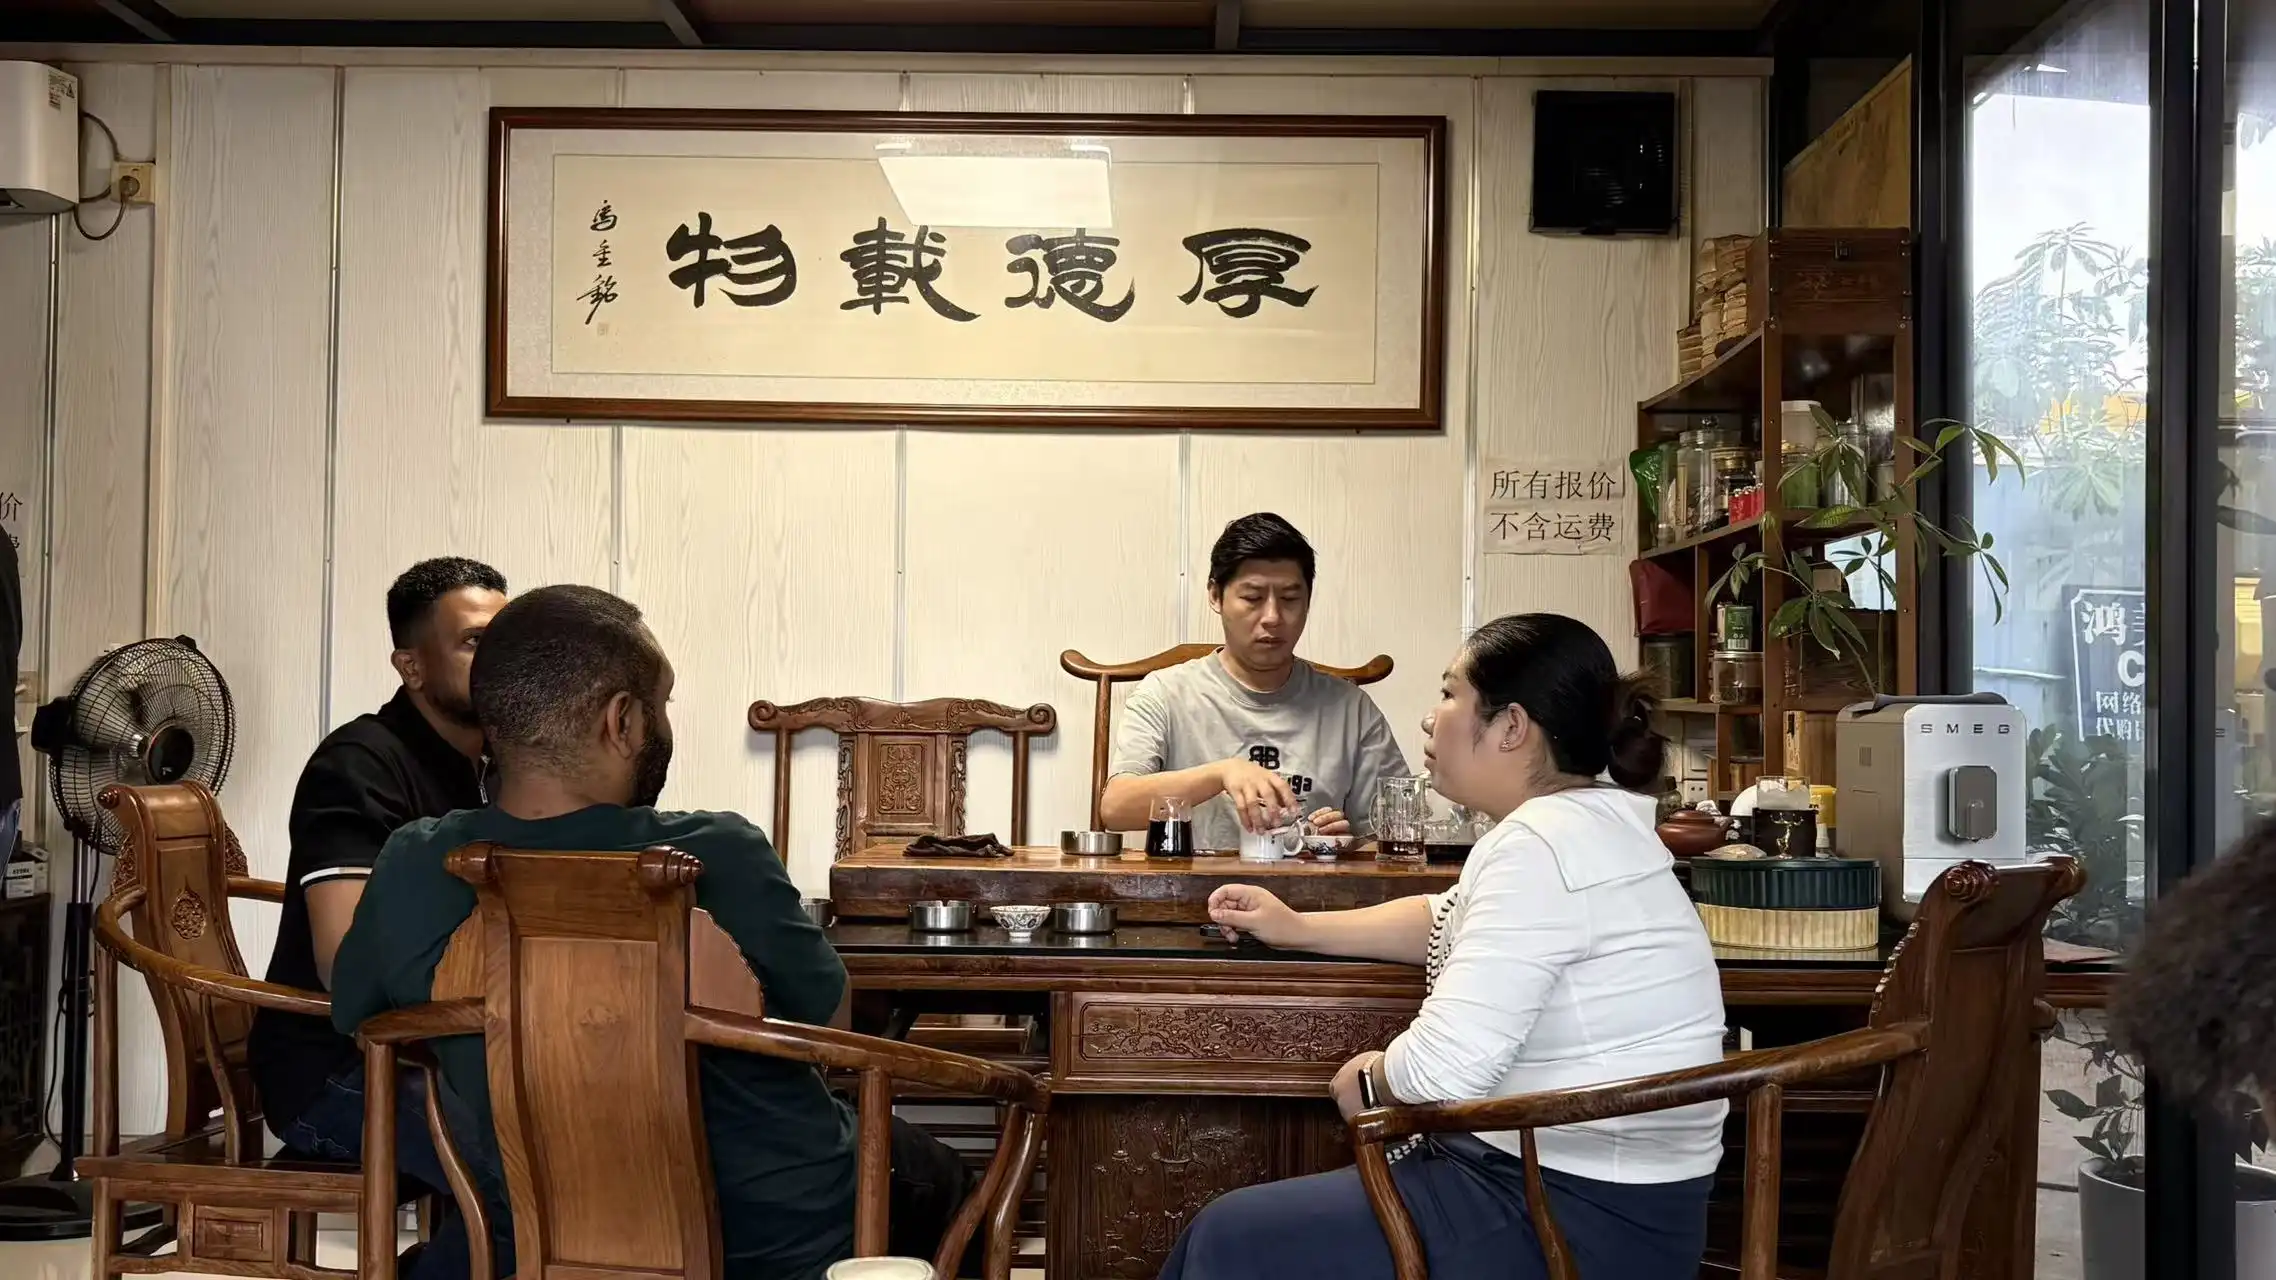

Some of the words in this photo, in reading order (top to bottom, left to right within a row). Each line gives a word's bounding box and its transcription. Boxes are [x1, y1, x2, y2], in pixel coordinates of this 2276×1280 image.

[1490, 470, 1616, 500] 所有报价
[1490, 512, 1615, 542] 不含运费
[1920, 723, 2010, 734] SMEG
